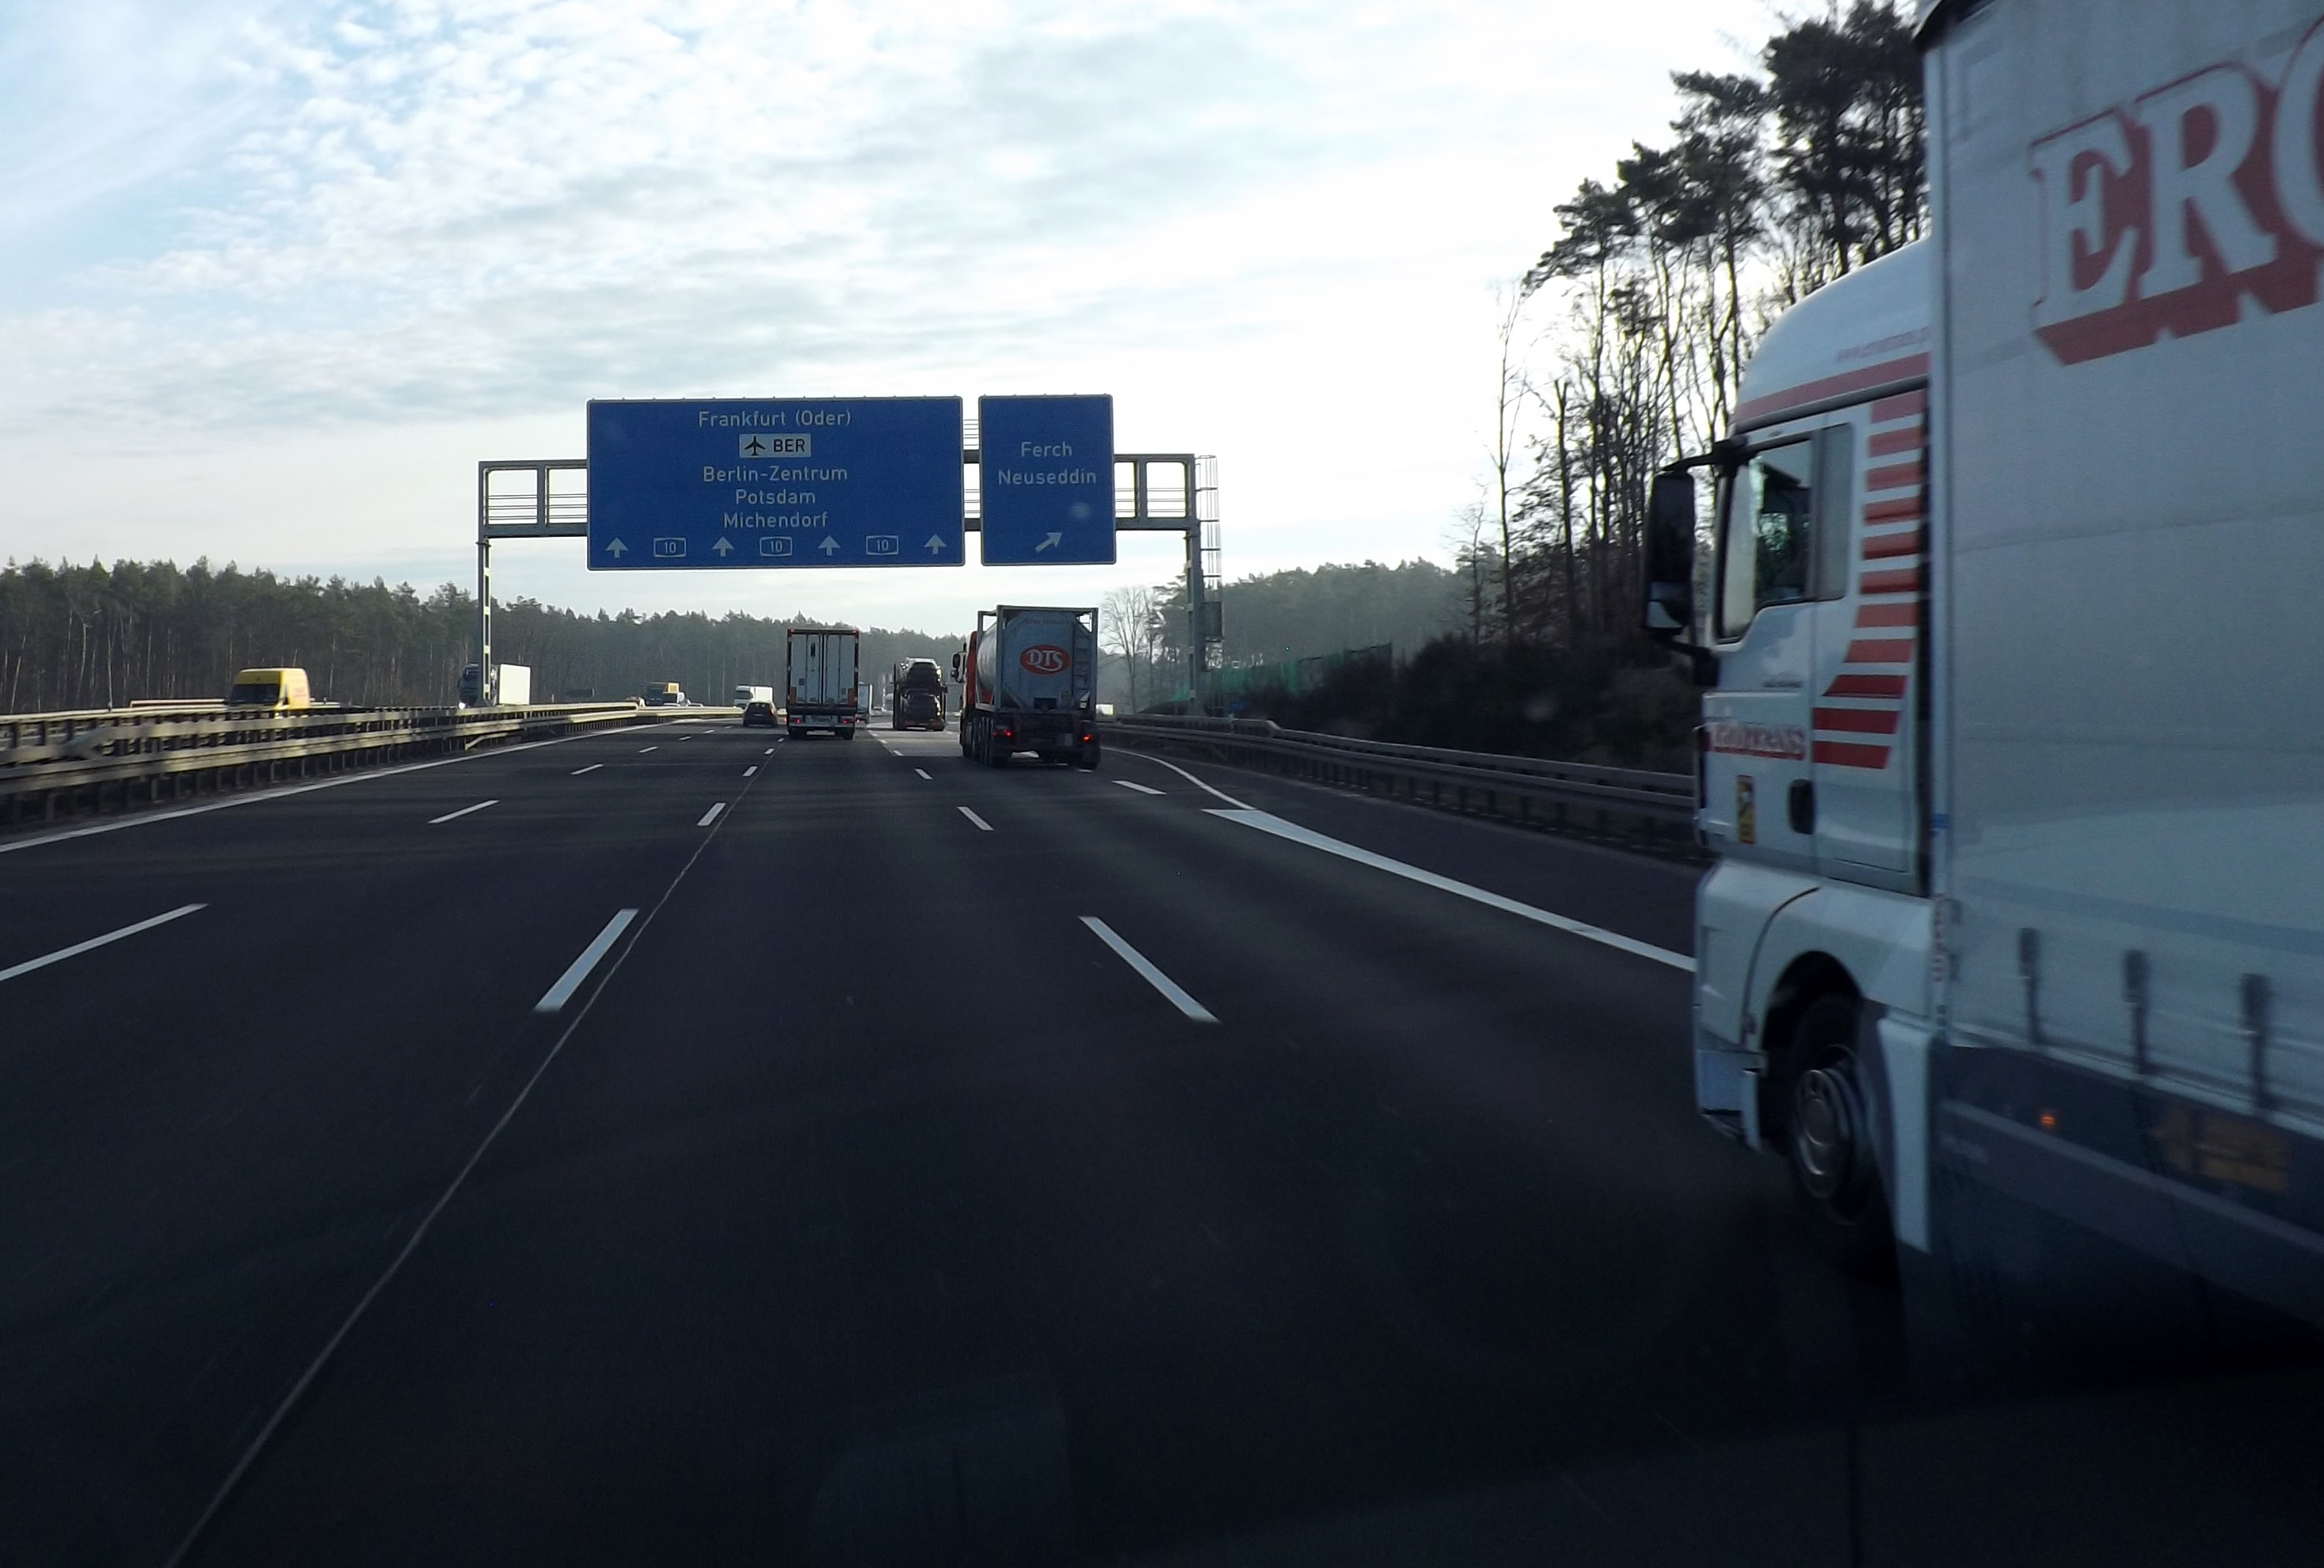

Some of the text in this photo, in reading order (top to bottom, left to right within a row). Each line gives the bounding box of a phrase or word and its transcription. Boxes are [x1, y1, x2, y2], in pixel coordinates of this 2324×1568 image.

[698, 409, 851, 427] Frankfurt (Oder)
[772, 438, 806, 453] BER
[1021, 441, 1072, 458] Ferch
[703, 465, 848, 482] Berlin-Zentrum
[998, 468, 1096, 485] Neuseddin
[735, 489, 816, 504] Potsdam
[723, 512, 828, 528] Michendorf
[663, 541, 676, 554] 10
[769, 540, 783, 554] 10
[875, 539, 889, 553] 10
[1027, 649, 1063, 672] DTS
